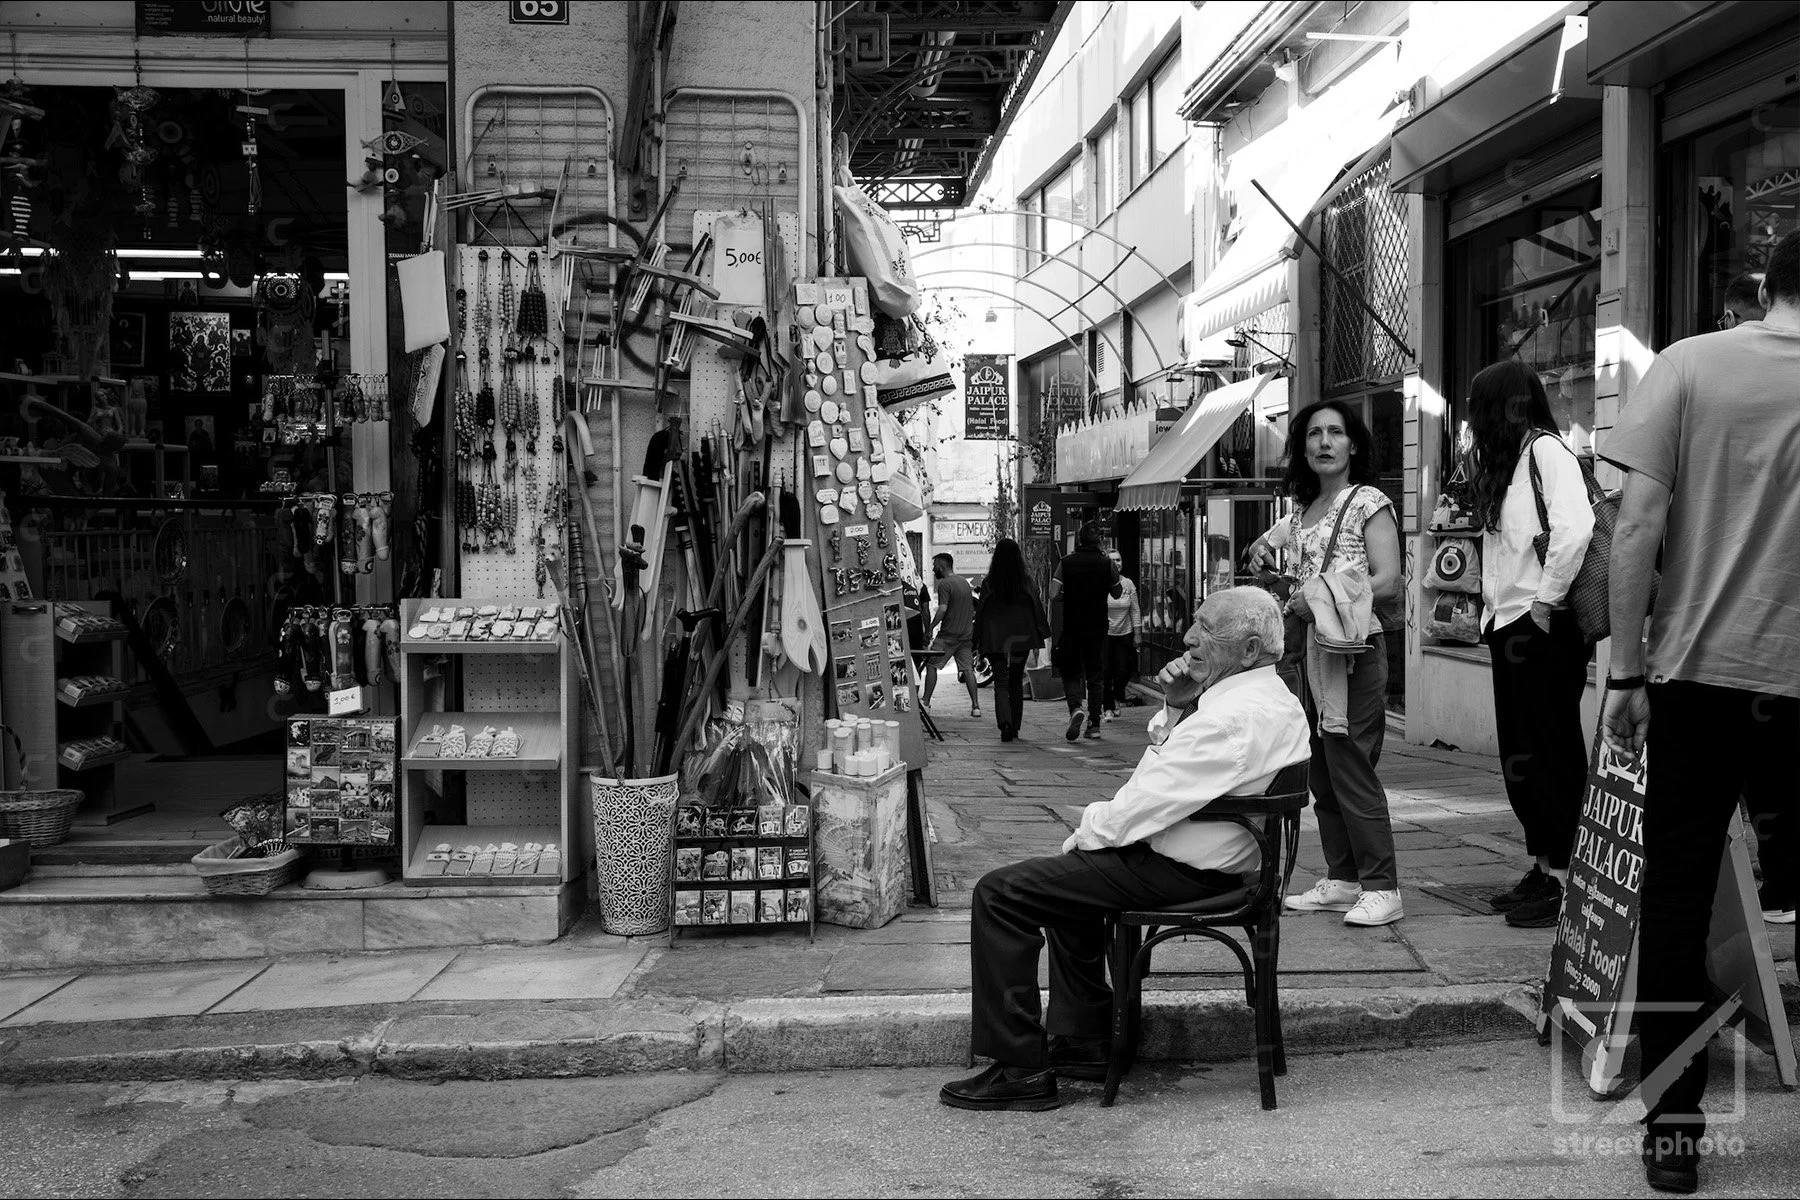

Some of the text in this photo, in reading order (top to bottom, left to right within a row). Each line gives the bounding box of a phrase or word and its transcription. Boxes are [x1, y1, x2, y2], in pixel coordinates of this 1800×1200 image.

[520, 1, 559, 17] 65
[237, 14, 266, 25] beauty!
[725, 248, 762, 268] 5,00€
[966, 386, 1007, 396] JAIPUR
[967, 396, 1008, 405] PALACE
[989, 417, 1008, 426] Fod)
[1583, 784, 1644, 846] JAIPUR
[1574, 825, 1644, 894] PALACE
[1586, 884, 1615, 910] restaurant
[1615, 902, 1629, 918] and
[1557, 914, 1622, 991] (Halal Food)
[1563, 958, 1601, 1001] (Since 2000)
